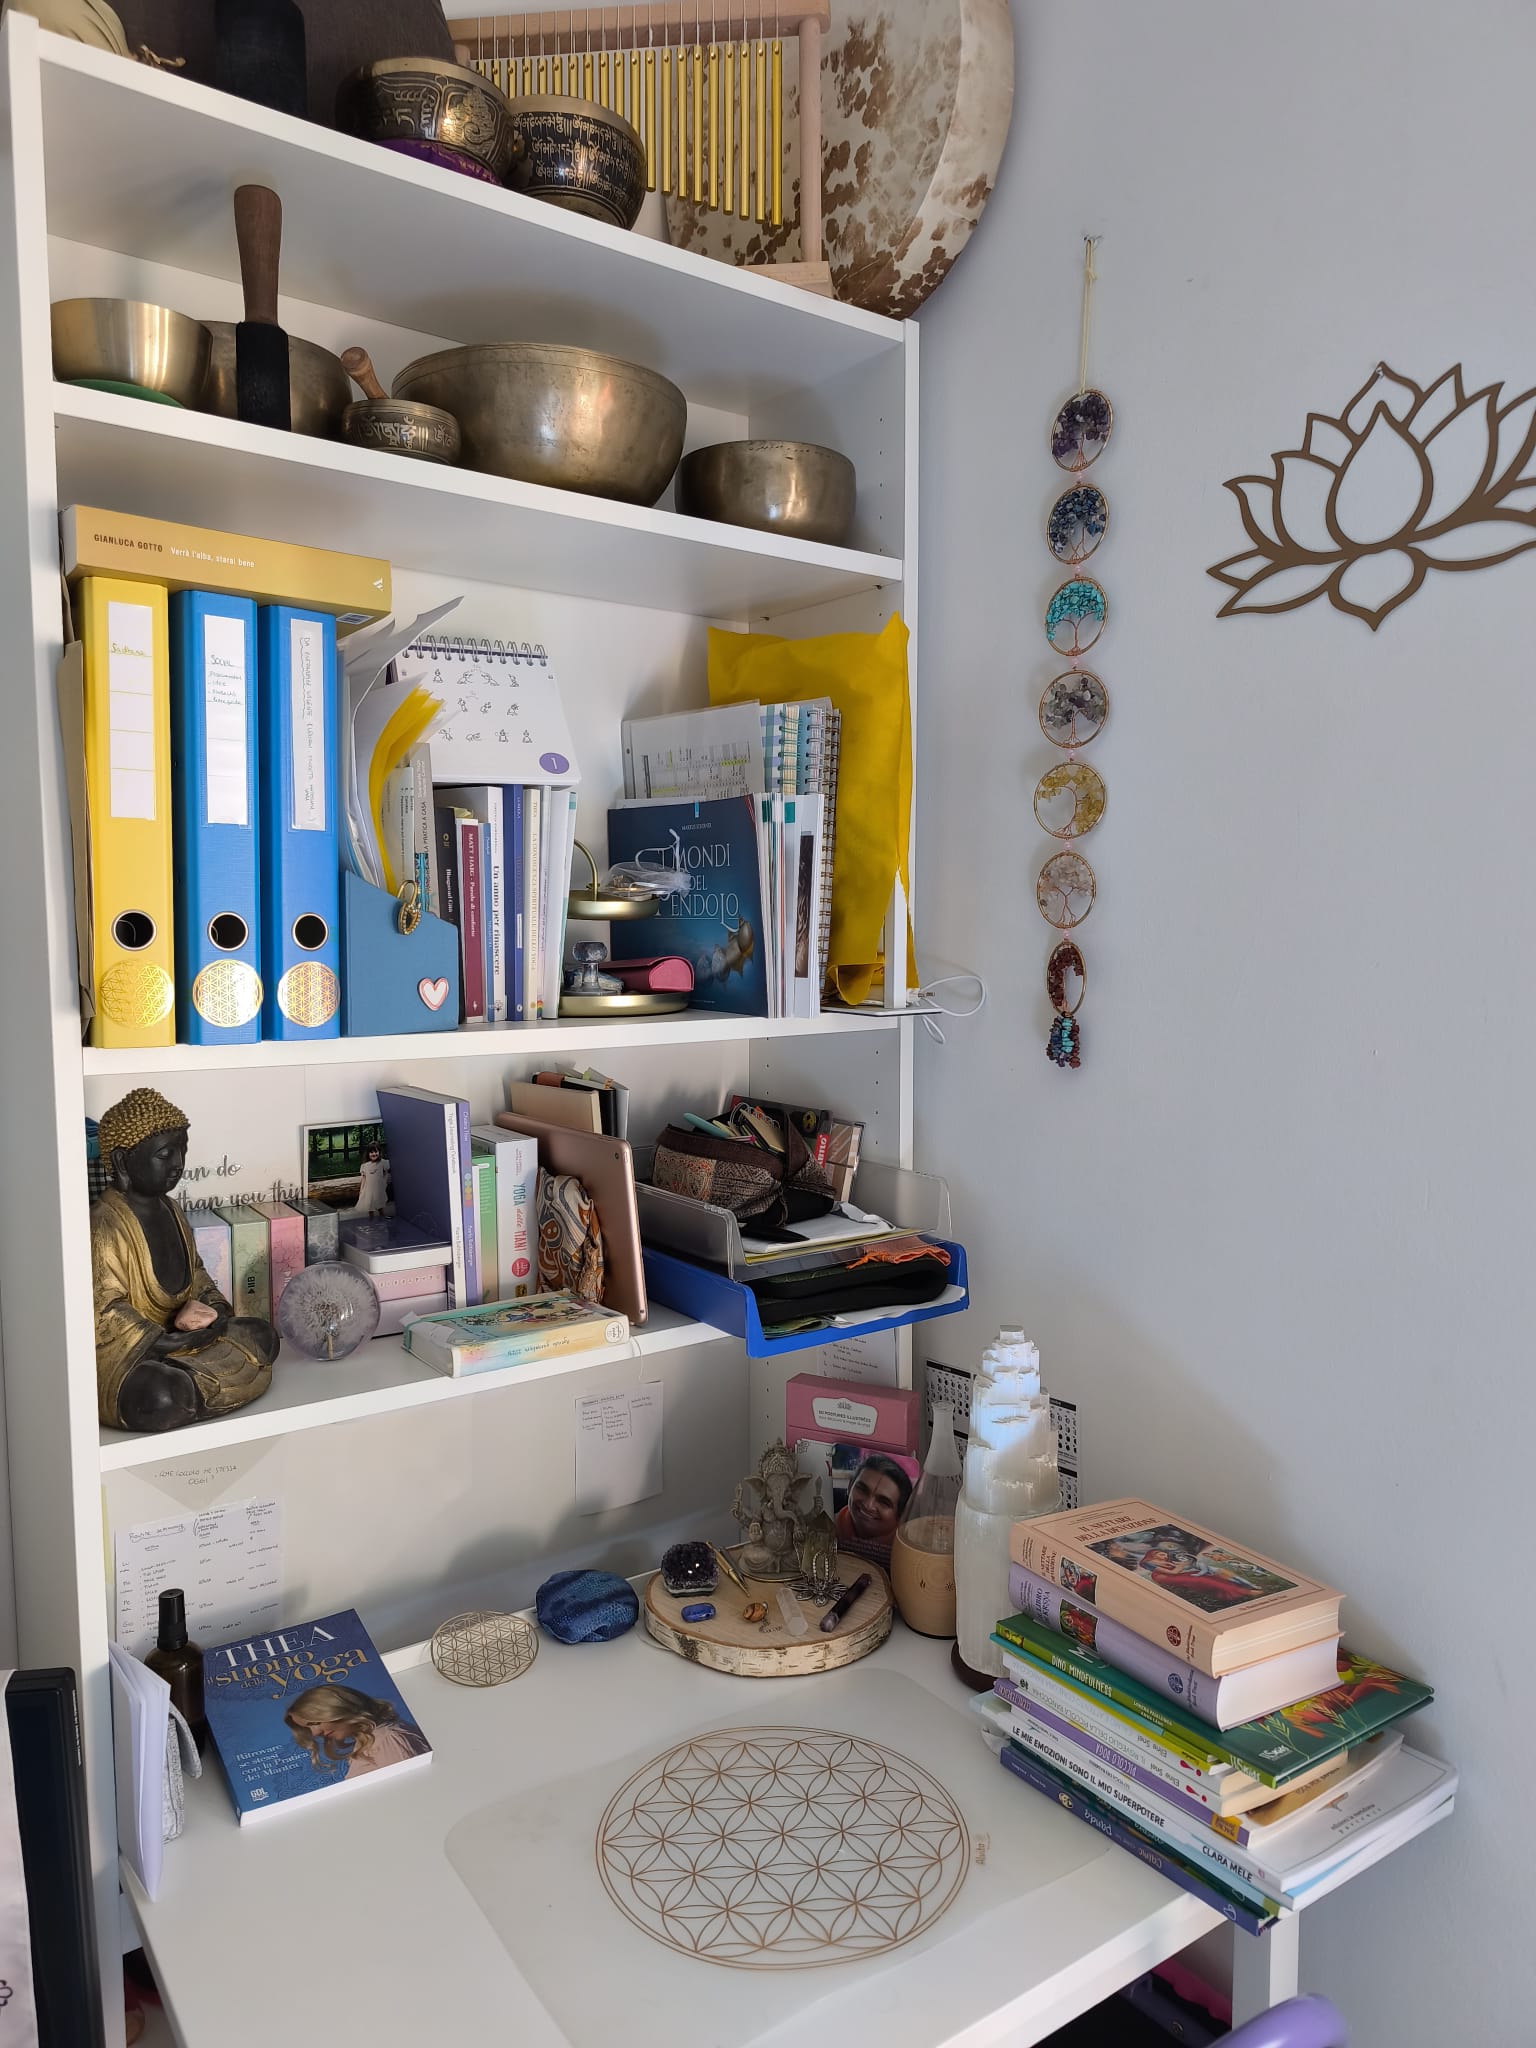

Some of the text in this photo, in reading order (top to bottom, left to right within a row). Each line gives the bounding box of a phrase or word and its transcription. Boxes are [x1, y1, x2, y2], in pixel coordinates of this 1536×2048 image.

[94, 534, 135, 547] GIANLUCA
[138, 541, 162, 552] GOTTO
[216, 554, 236, 565] starai
[238, 558, 255, 568] bene
[672, 843, 731, 873] MONDI
[493, 866, 500, 879] Un
[690, 874, 708, 891] DEL
[492, 910, 500, 926] per
[493, 929, 501, 976] rinascere
[216, 1154, 241, 1177] do
[177, 1189, 224, 1212] than
[230, 1190, 267, 1207] you
[513, 1183, 527, 1207] YOGA
[516, 1208, 524, 1228] delle
[514, 1230, 528, 1252] MANI
[1074, 1517, 1160, 1542] DELLA DEVOZIONE
[1091, 1515, 1134, 1530] NETTARE
[216, 1626, 341, 1669] THEA
[215, 1651, 315, 1687] suono
[241, 1648, 371, 1699] dello yoga
[1051, 1655, 1113, 1698] DINO MINDFULNESS
[236, 1744, 284, 1761] Ritrovare
[1138, 1735, 1168, 1758] Eline Snel
[239, 1752, 279, 1769] se stessi
[242, 1751, 309, 1775] con la Pratica
[1095, 1742, 1137, 1777] PICCOLO YOGA
[1150, 1764, 1163, 1776] Snel
[244, 1763, 300, 1783] dei Mantra
[1165, 1772, 1180, 1787] Eline
[1012, 1725, 1020, 1736] LE
[1021, 1731, 1033, 1744] MIE
[1034, 1739, 1067, 1767] EMOZIONI
[1068, 1761, 1089, 1780] SONO
[1090, 1775, 1097, 1785] IL
[1097, 1779, 1113, 1795] MIO
[1113, 1789, 1165, 1828] SUPERPOTERE
[1202, 1846, 1229, 1867] CLARA
[1229, 1859, 1254, 1882] MELE
